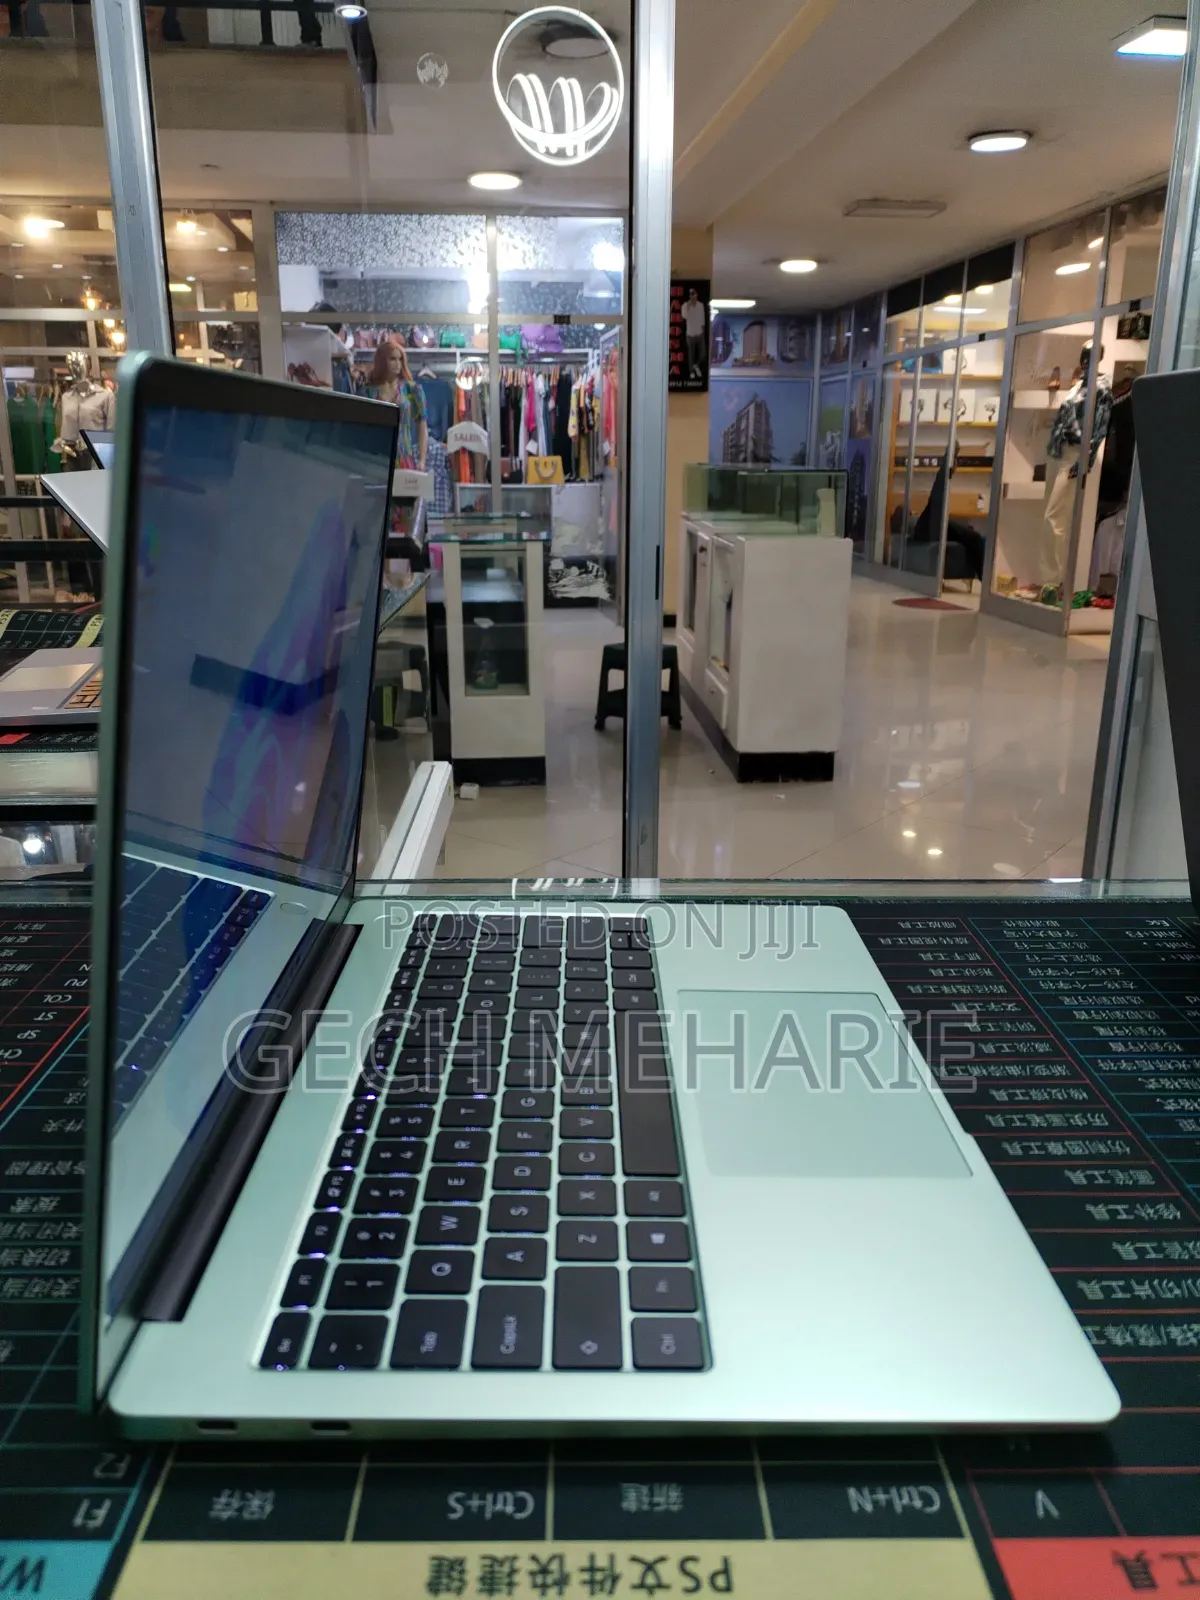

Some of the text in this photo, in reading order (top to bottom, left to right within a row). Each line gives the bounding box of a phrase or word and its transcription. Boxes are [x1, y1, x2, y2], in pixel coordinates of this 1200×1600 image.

[64, 978, 88, 987] PU
[43, 994, 72, 1003] COL
[952, 1002, 1021, 1012] 文字工具
[34, 1012, 57, 1020] ST
[17, 1030, 41, 1039] SP
[985, 1113, 1108, 1127] 历史画笔工具
[1002, 1140, 1130, 1155] 仿制图章工具
[578, 1151, 596, 1163] C
[513, 1165, 531, 1177] D
[1064, 1169, 1155, 1186] 画笔工具
[578, 1190, 596, 1200] X
[510, 1205, 529, 1217] S
[439, 1214, 459, 1231] W
[578, 1233, 598, 1244] Z
[506, 1250, 525, 1263] A
[431, 1261, 452, 1276] Q
[208, 1488, 275, 1521] 保存
[446, 1490, 535, 1519] Ctrl+S
[619, 1482, 684, 1513] 新建
[846, 1484, 941, 1513] Ctrl+N
[1033, 1488, 1060, 1519] V
[72, 1498, 112, 1530] F1
[425, 1553, 733, 1596] PS文件快捷键
